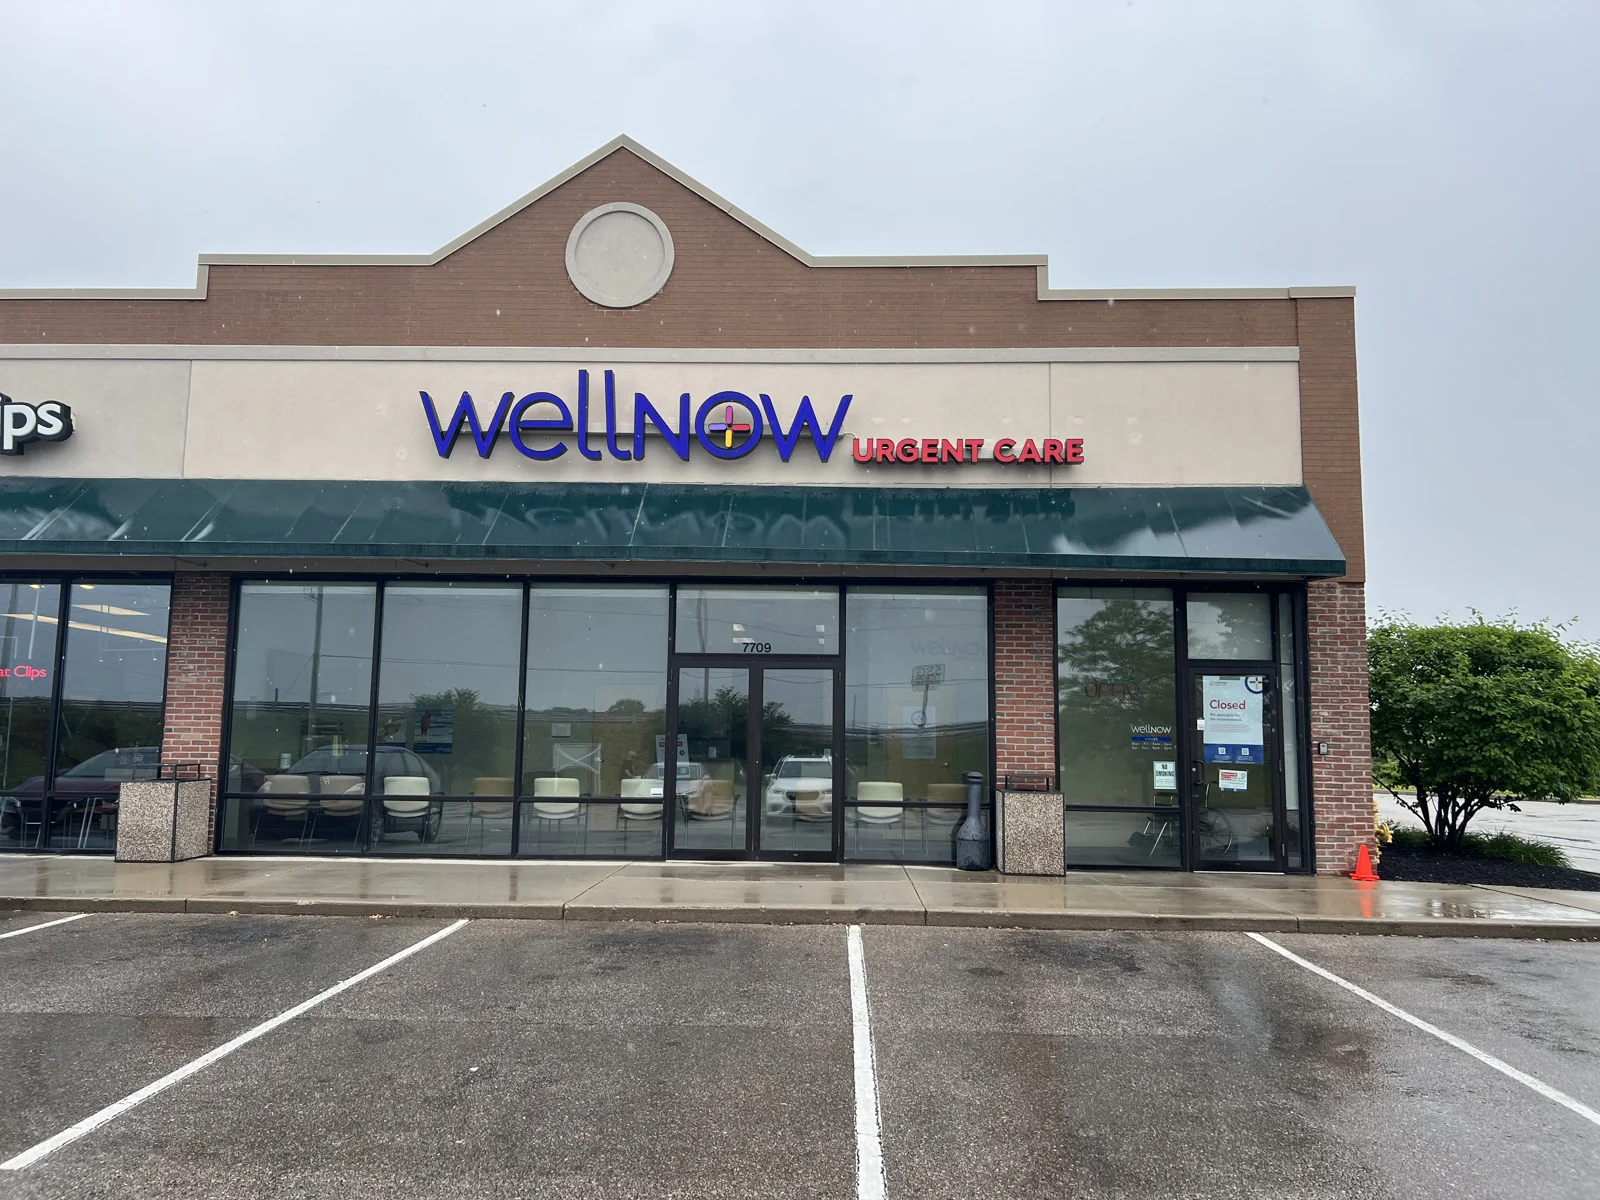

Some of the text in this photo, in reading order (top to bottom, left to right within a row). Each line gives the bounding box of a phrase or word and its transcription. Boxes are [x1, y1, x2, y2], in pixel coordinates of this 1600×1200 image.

[853, 438, 1085, 465] URGENT CARE
[742, 642, 772, 653] 7709
[13, 665, 47, 681] Clips
[1209, 699, 1246, 710] Closed
